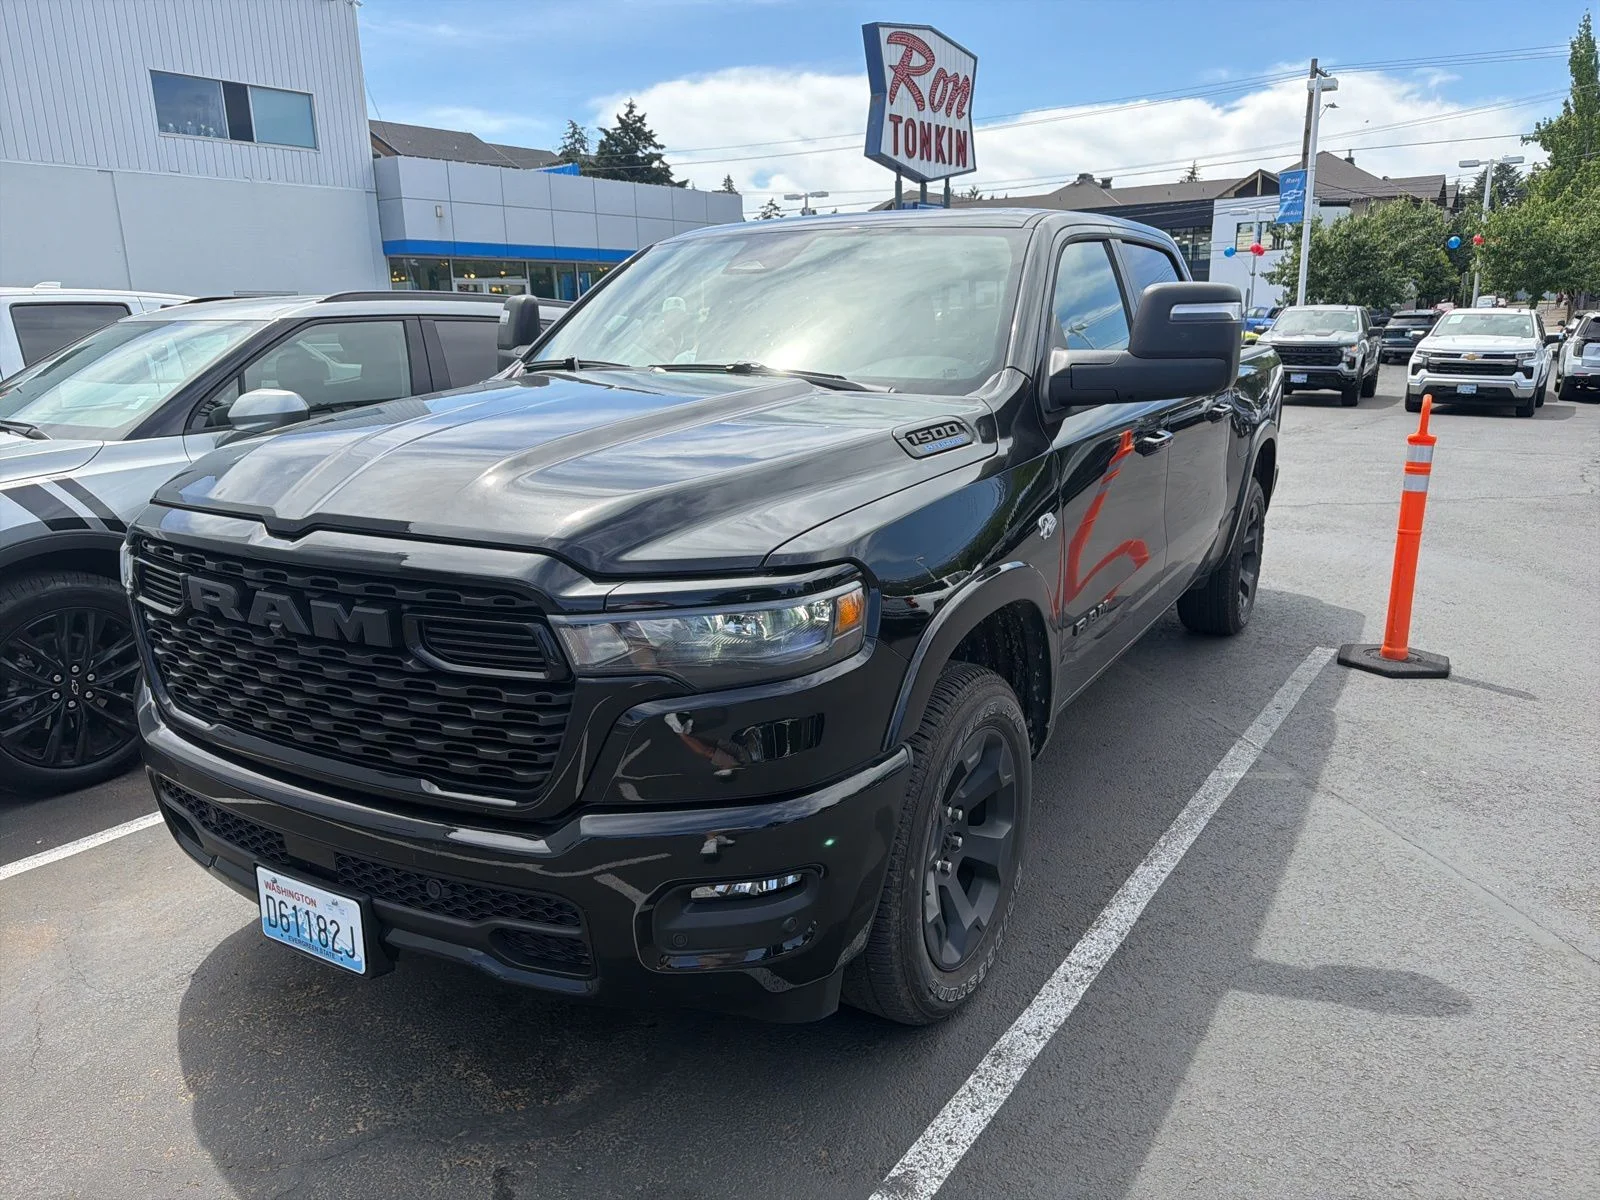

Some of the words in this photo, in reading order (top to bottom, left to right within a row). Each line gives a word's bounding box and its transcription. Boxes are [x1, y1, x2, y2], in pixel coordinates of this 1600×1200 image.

[887, 30, 970, 119] Ron
[889, 113, 967, 168] TONKIN
[907, 423, 960, 445] 1500
[187, 574, 393, 648] RAM
[264, 880, 317, 908] WASHINGTON
[265, 894, 355, 959] D61182J
[288, 935, 319, 952] EVERGREEN
[319, 946, 336, 960] STATE
